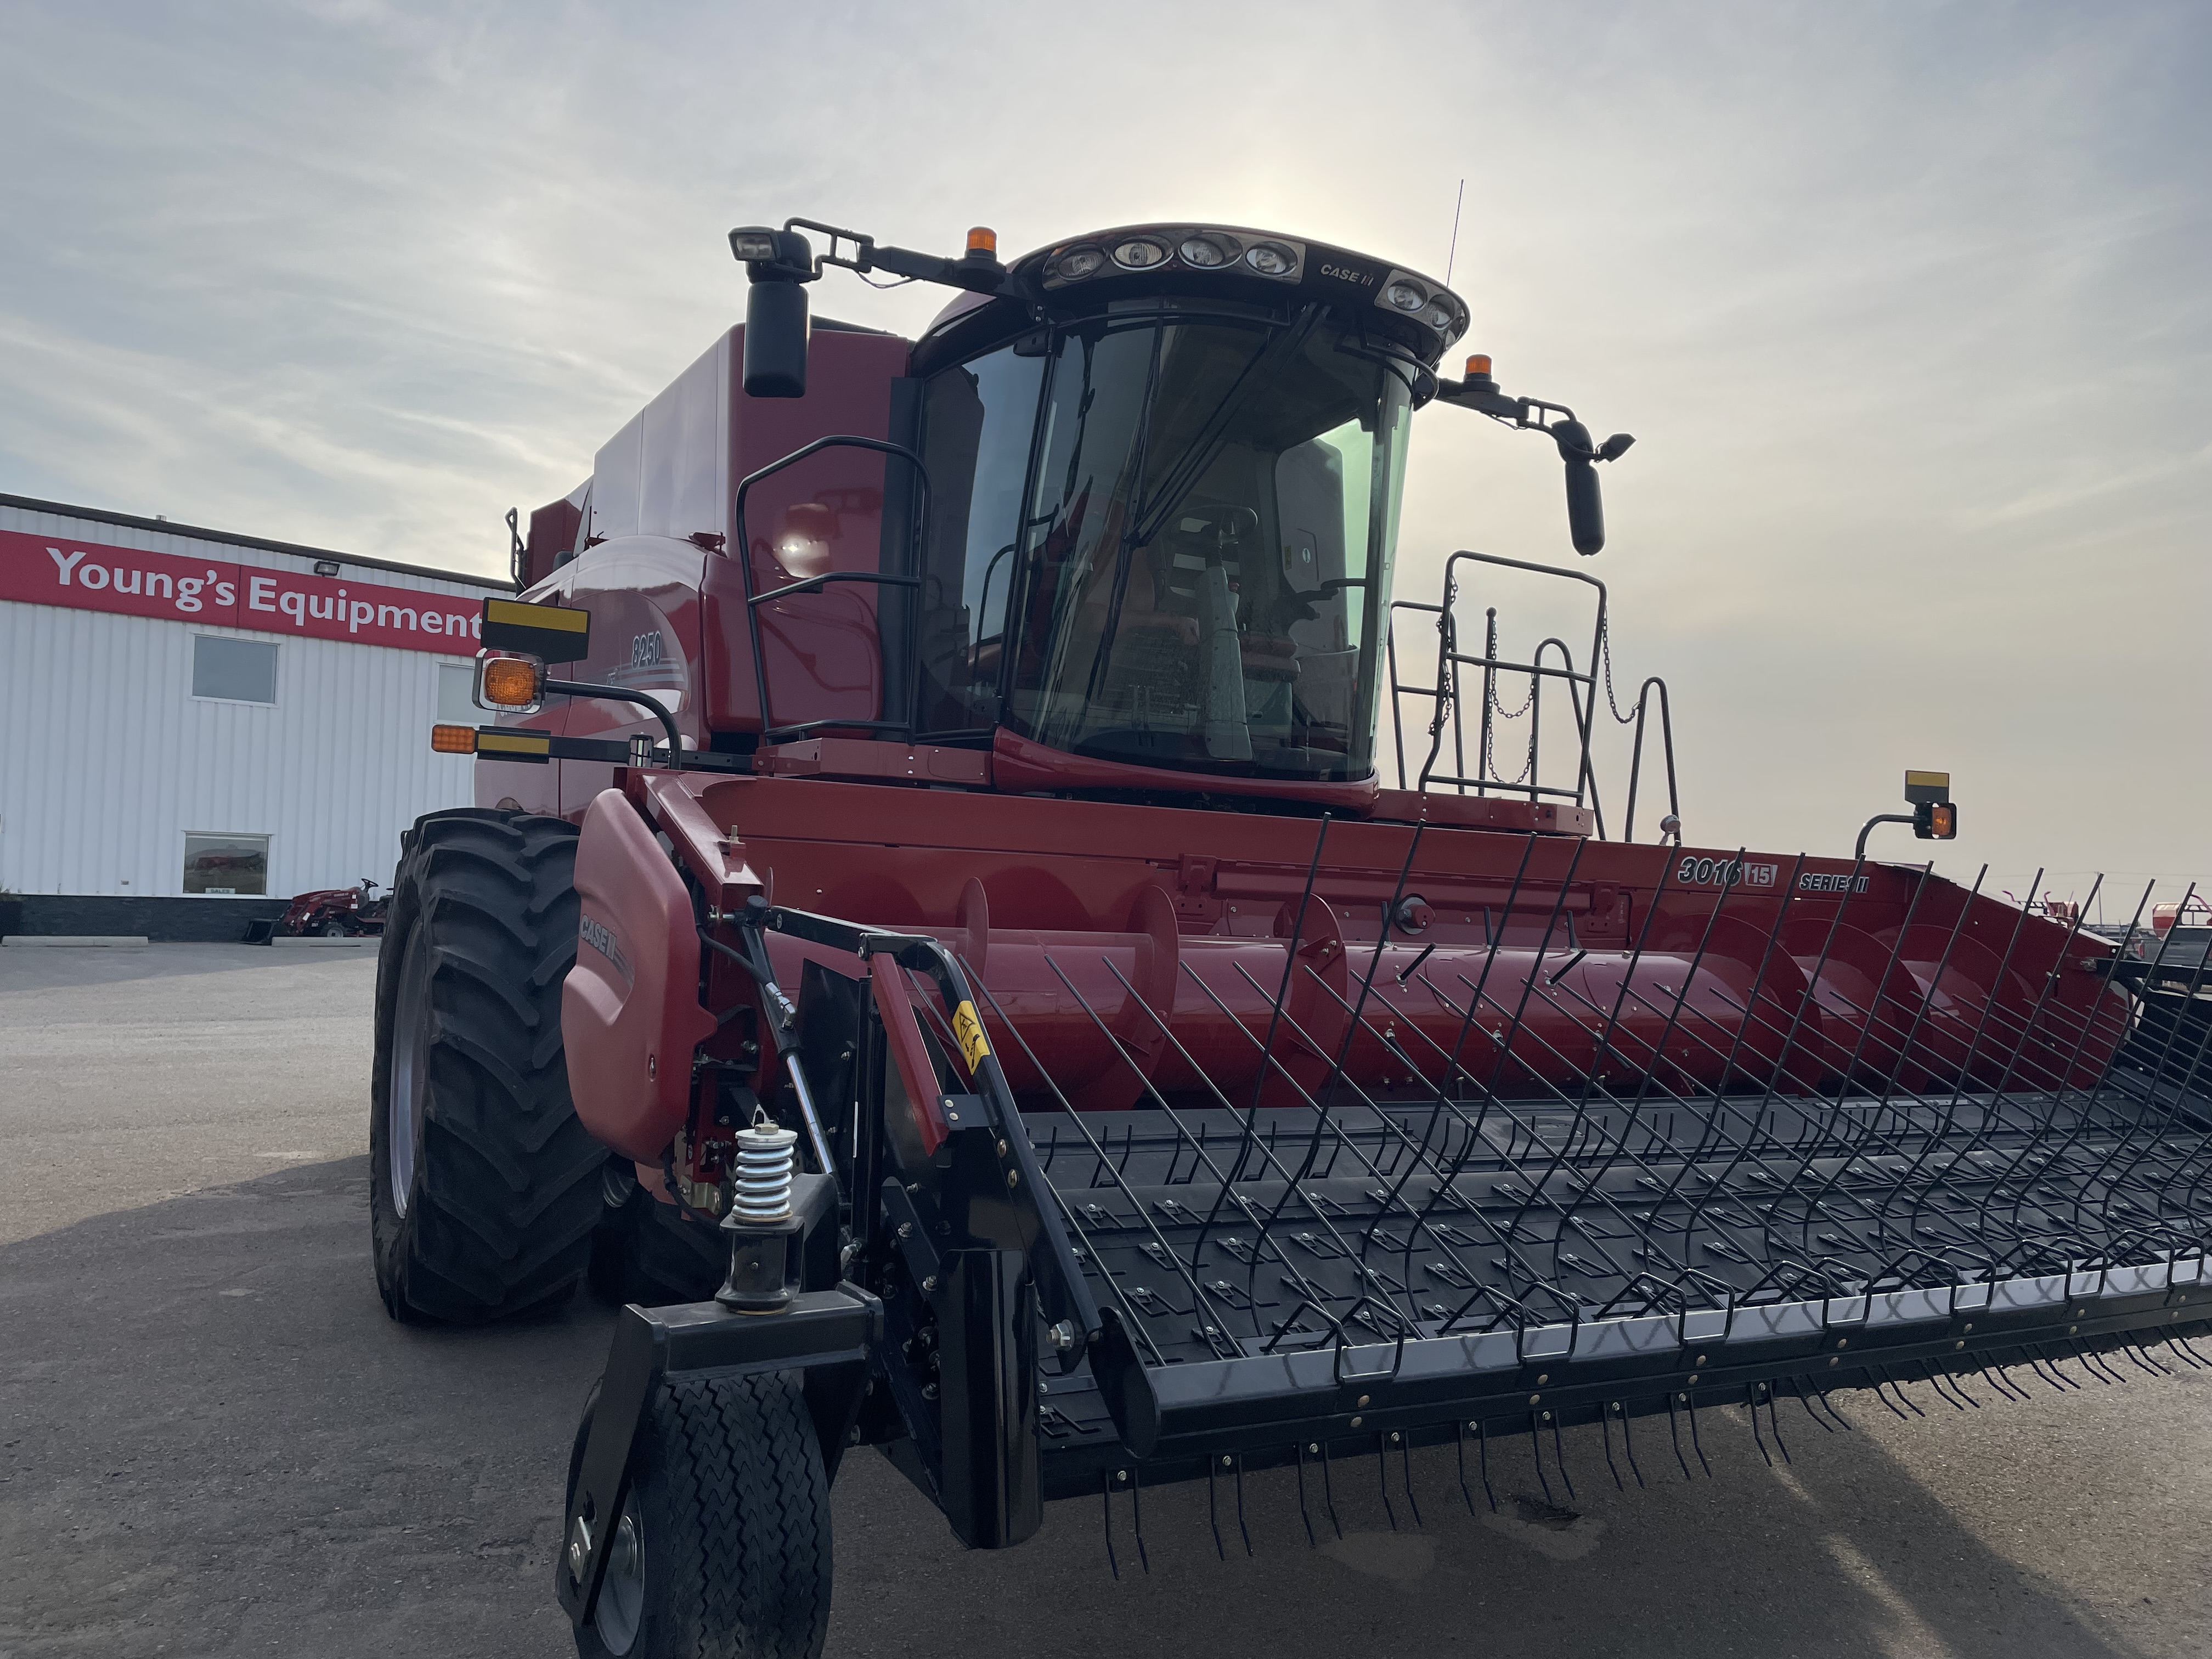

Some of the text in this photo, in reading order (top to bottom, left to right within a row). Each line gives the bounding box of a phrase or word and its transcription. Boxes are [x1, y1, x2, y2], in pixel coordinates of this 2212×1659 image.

[1321, 264, 1360, 283] CASE
[46, 548, 482, 639] Young's Equipment
[631, 630, 662, 670] 8250
[1678, 856, 1743, 887] 3016
[1752, 867, 1769, 884] 15
[1856, 876, 1870, 893] II
[580, 914, 608, 953] CASE
